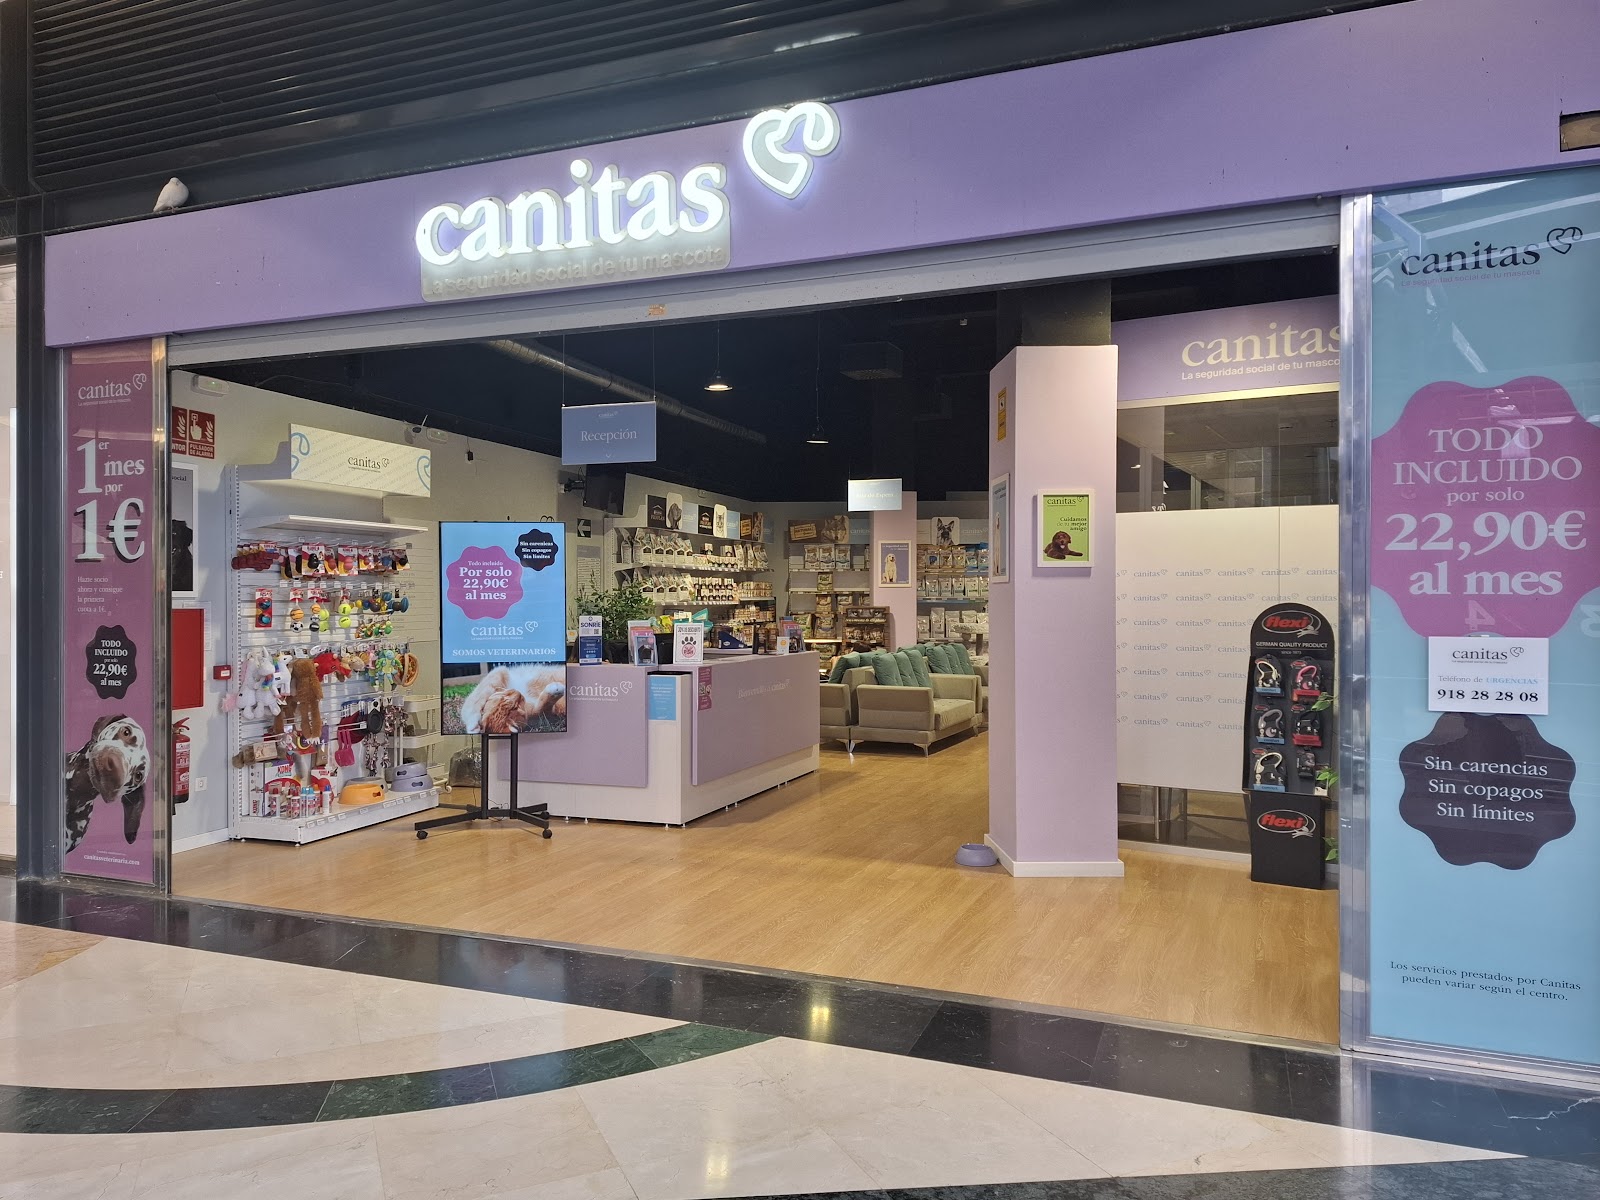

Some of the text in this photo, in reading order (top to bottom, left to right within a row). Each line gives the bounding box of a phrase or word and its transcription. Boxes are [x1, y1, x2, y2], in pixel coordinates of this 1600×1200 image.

[415, 158, 727, 265] canitas
[1401, 241, 1541, 275] canitas
[447, 268, 530, 294] seguridad
[535, 262, 589, 283] social
[591, 258, 616, 277] de
[619, 254, 639, 274] tu
[643, 246, 725, 271] mascota
[1455, 273, 1479, 283] social
[1481, 272, 1492, 280] de
[1494, 271, 1502, 279] tu
[1504, 269, 1541, 278] mascota
[1182, 371, 1193, 380] La
[1195, 366, 1244, 380] seguridad
[1246, 363, 1275, 374] social
[1278, 361, 1291, 372] de
[1293, 359, 1303, 369] tu
[78, 380, 132, 399] canitas
[581, 428, 637, 444] Recepción
[1428, 425, 1543, 452] TODO
[190, 444, 214, 453] PULSADOR
[196, 450, 214, 458] ALARMA
[104, 459, 145, 477] mes
[347, 456, 381, 469] canitas
[1393, 456, 1582, 485] INCLUIDO
[104, 482, 123, 495] por
[1047, 497, 1077, 505] canitas
[1446, 487, 1525, 506] por solo
[75, 498, 146, 562] 1€
[1385, 510, 1587, 561] 22,90€
[459, 567, 512, 577] Por solo
[1409, 561, 1563, 596] al mes
[463, 578, 509, 590] 22,90€
[465, 590, 506, 600] al mes
[1266, 616, 1310, 628] flexi
[471, 624, 523, 636] canitas
[487, 648, 556, 656] VETERINARIOS
[1452, 648, 1508, 660] canitas
[93, 663, 128, 677] 22,90€
[1438, 675, 1471, 683] Teléfono
[1486, 677, 1538, 685] URGENCIAS
[570, 683, 618, 697] canitas
[1437, 688, 1538, 702] 918 28 28 08
[1218, 722, 1244, 730] canita
[1424, 755, 1548, 776] Sin carencias
[1428, 779, 1544, 802] Sin copagos
[1437, 802, 1535, 822] Sin límites
[1261, 814, 1304, 828] flexi
[1390, 961, 1581, 991] Los servicios prestados por Canitas
[1402, 974, 1568, 1001] pueden variar según el centro.
